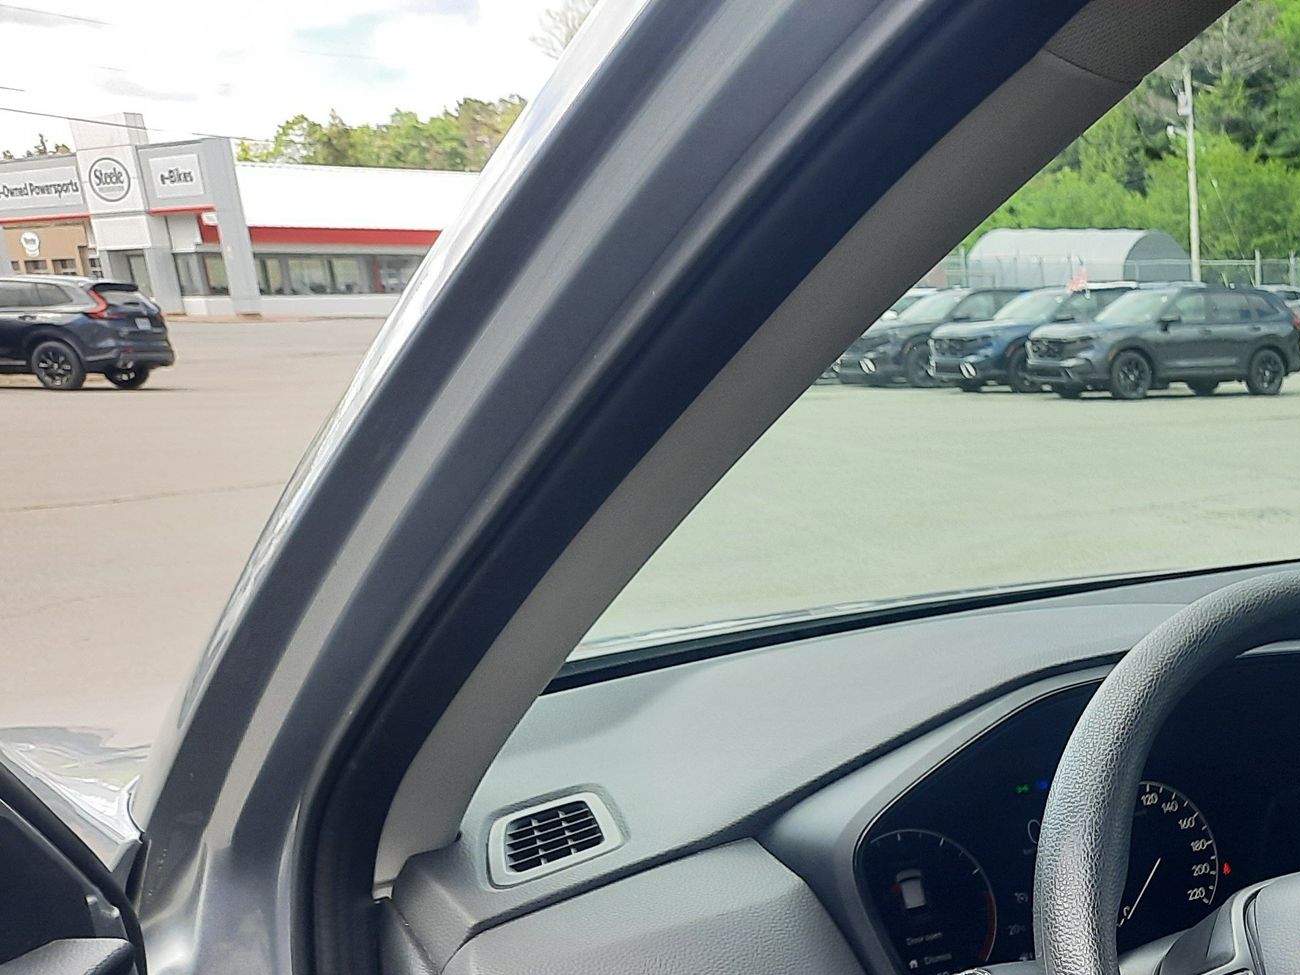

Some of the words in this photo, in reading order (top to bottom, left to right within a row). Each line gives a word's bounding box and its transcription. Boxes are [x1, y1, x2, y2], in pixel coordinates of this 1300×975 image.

[94, 167, 124, 186] Steele
[160, 168, 194, 184] e-Bikes
[29, 180, 79, 199] Powersports
[1141, 793, 1158, 806] 120
[1161, 801, 1179, 814] 140
[1178, 817, 1195, 830] 160
[1190, 839, 1207, 852] 180
[1192, 863, 1210, 876] 200
[1187, 887, 1206, 900] 220
